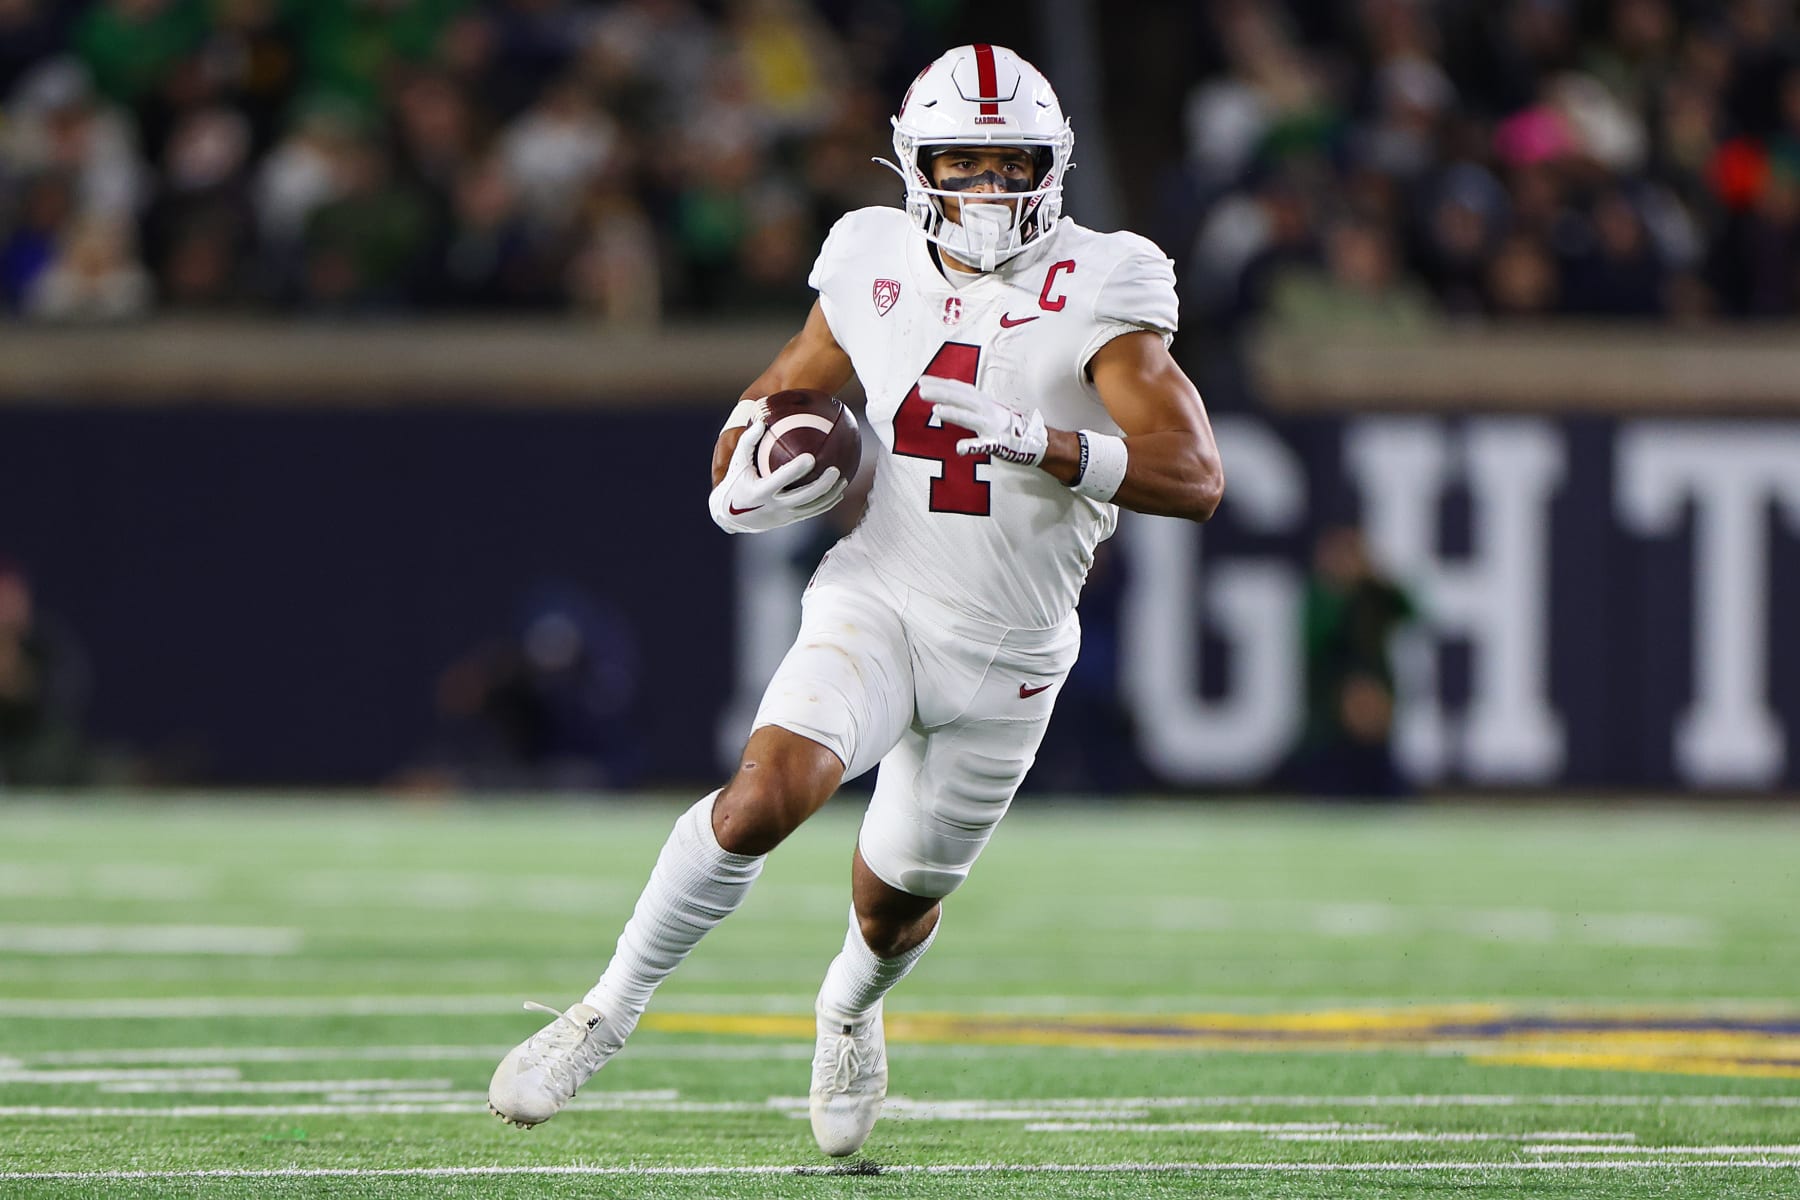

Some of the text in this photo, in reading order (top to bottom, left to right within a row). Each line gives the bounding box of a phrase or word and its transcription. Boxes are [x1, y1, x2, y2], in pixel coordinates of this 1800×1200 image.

[875, 280, 900, 304] PAC
[877, 294, 891, 309] 12
[1038, 259, 1076, 313] C
[892, 341, 991, 517] 4
[714, 416, 1800, 787] GHT
